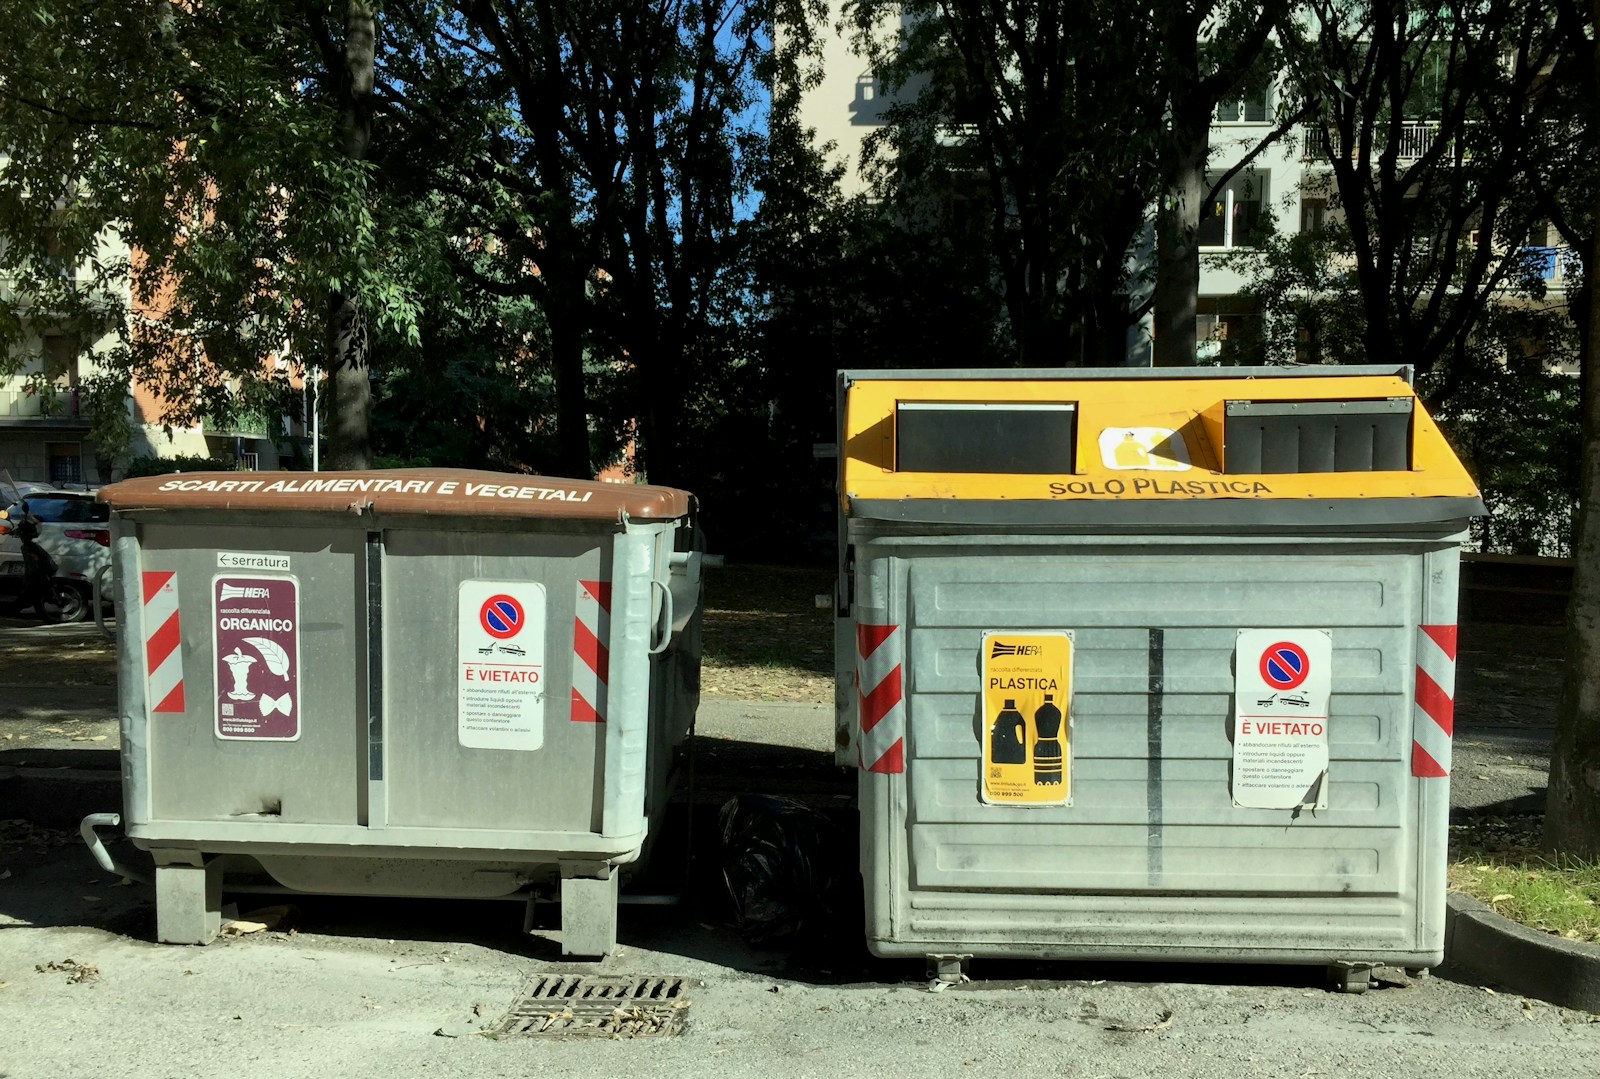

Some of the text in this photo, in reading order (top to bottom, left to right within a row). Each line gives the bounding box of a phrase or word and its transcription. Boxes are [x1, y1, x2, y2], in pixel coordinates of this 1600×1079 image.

[158, 479, 593, 502] SCARTI ALIMENTARI E VEGETALI
[1049, 477, 1272, 495] SOLO PLASTICA
[232, 556, 289, 568] serratura
[244, 587, 270, 598] HERA
[220, 617, 293, 632] ORGANICO
[1016, 645, 1042, 656] HERA
[466, 666, 539, 683] È VIETATO
[990, 677, 1058, 690] PLASTICA
[1242, 719, 1323, 736] È VIETATO
